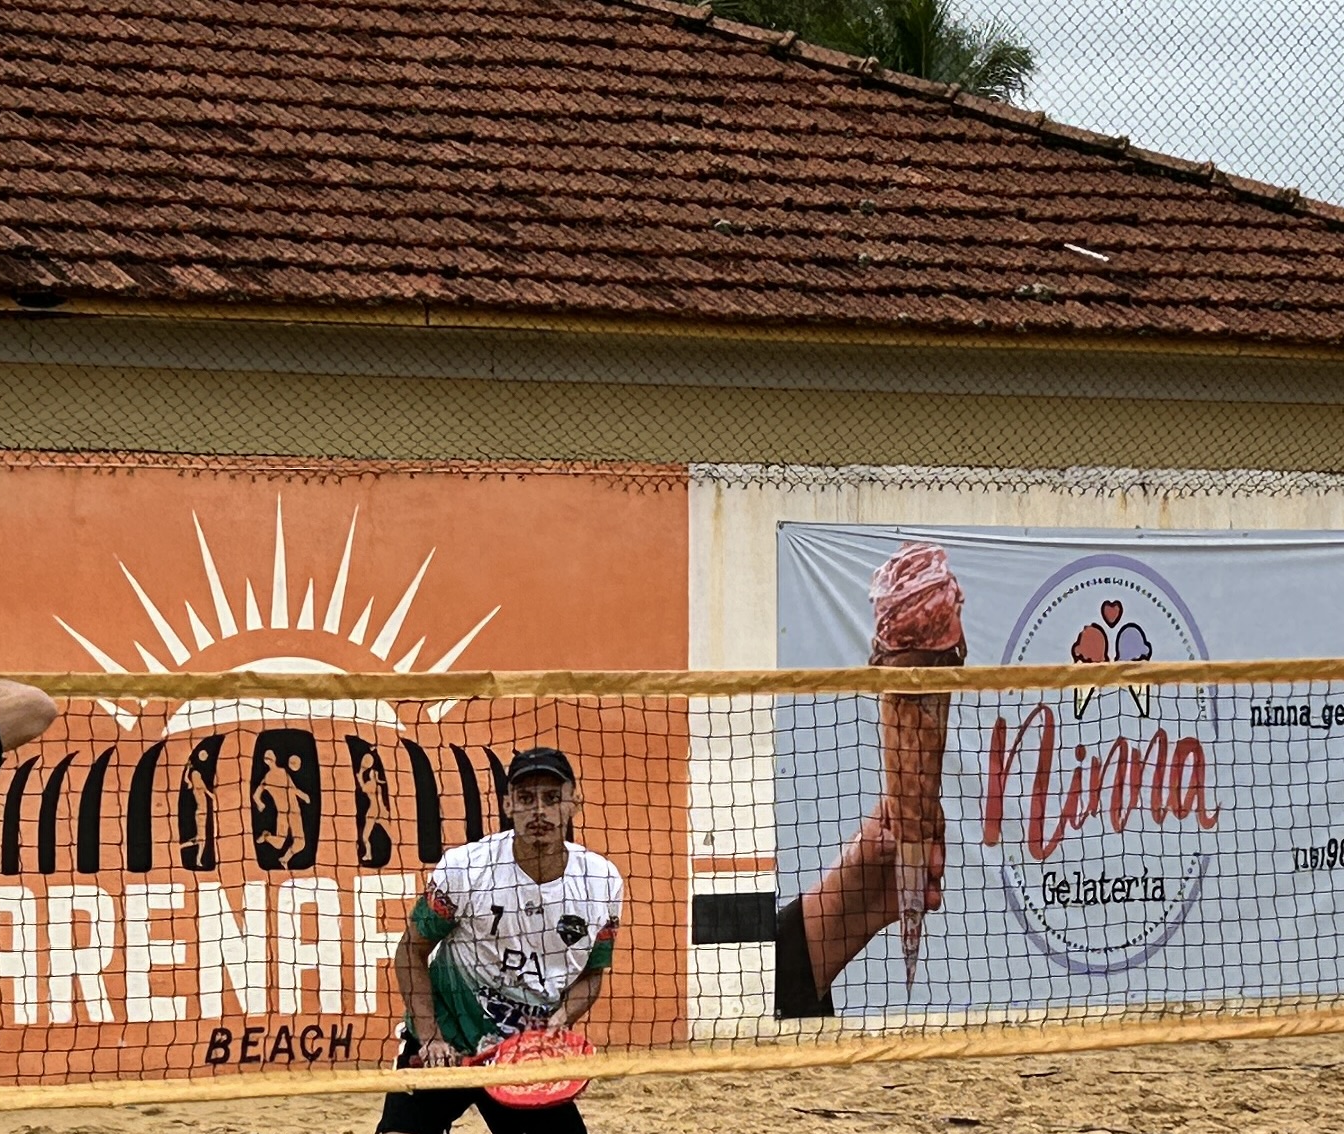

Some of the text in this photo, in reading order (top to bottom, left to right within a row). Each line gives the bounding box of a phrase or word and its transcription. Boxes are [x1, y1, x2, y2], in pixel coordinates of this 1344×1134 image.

[983, 703, 1221, 860] Ninna
[490, 905, 504, 936] 7
[205, 1022, 354, 1065] BEACH
